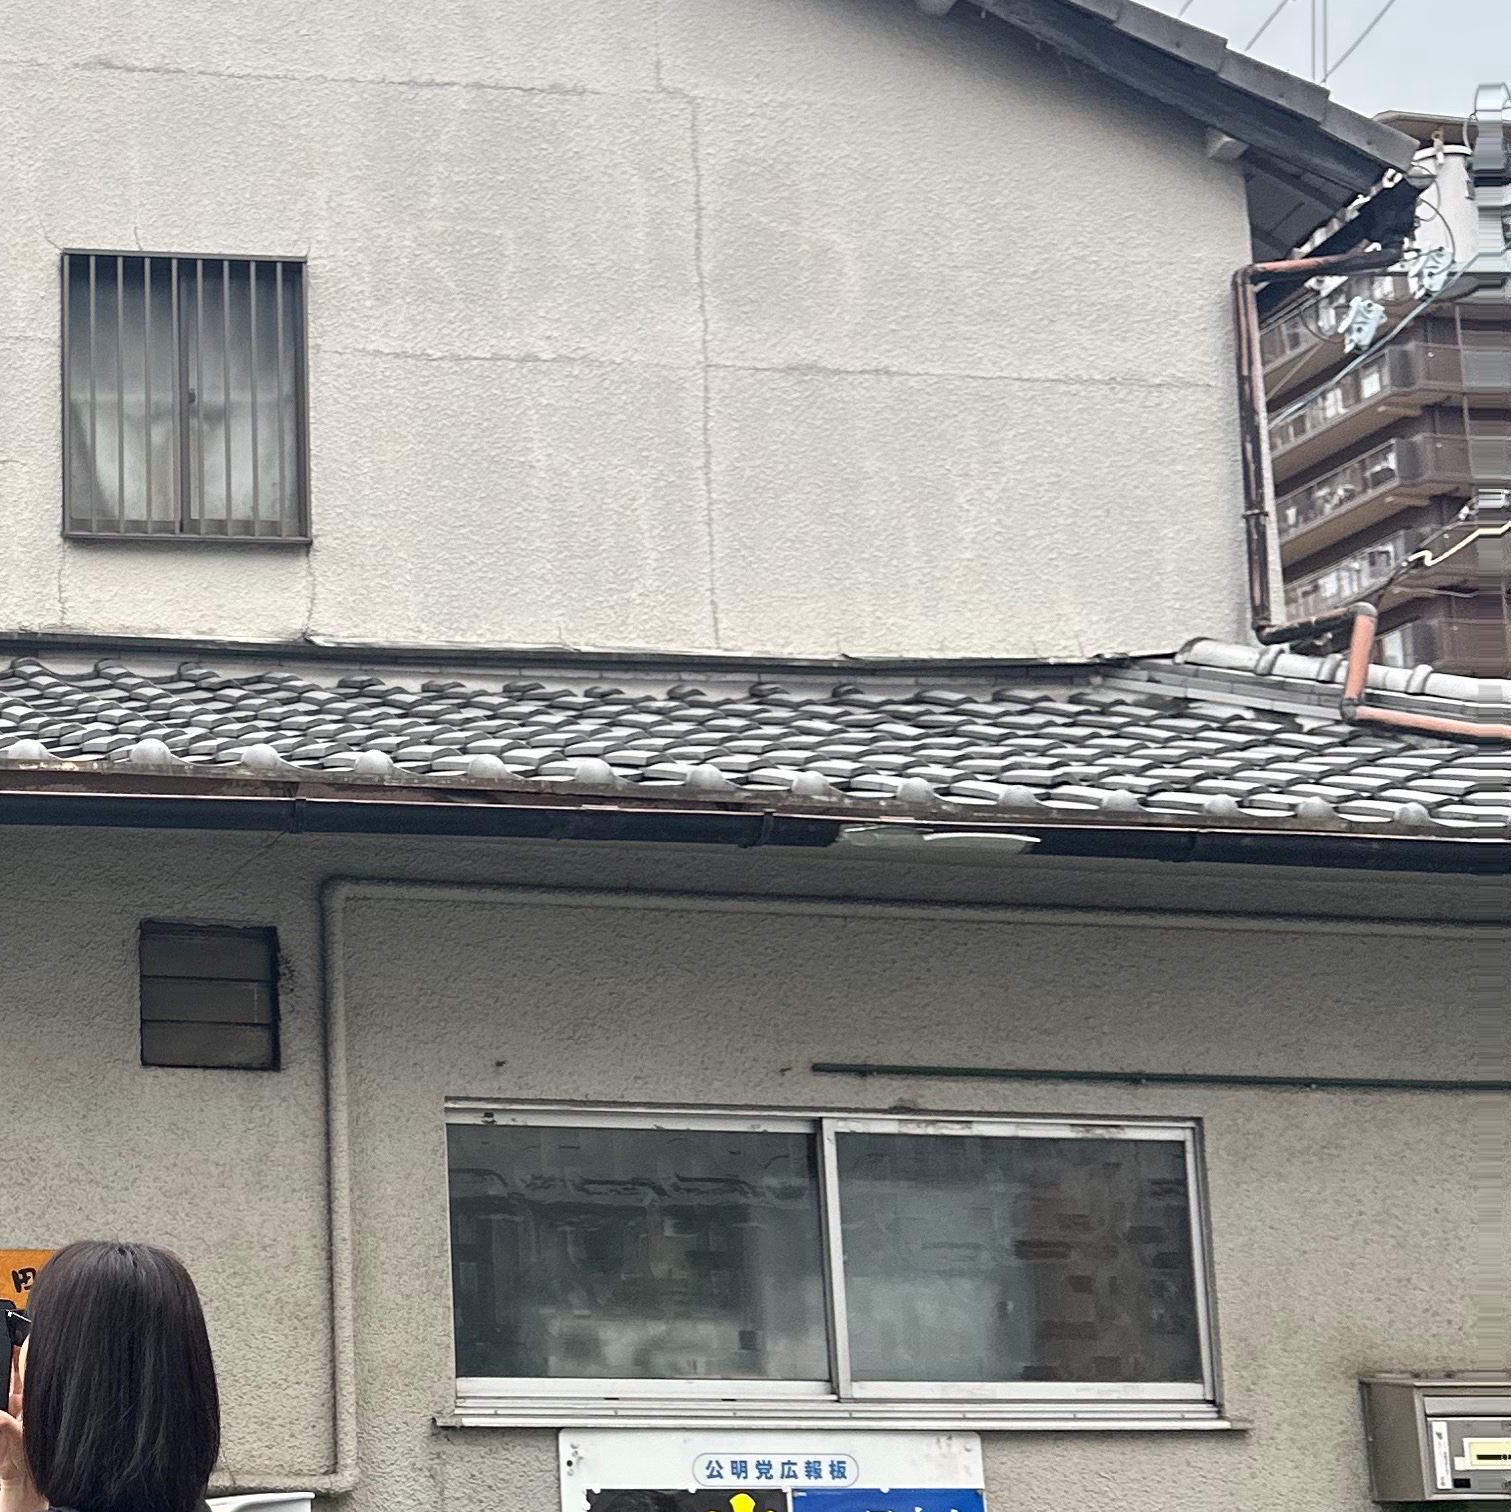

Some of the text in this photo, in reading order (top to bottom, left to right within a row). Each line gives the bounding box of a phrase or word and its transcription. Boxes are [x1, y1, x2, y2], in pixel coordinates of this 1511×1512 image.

[705, 1459, 848, 1480] 公明党広報板
